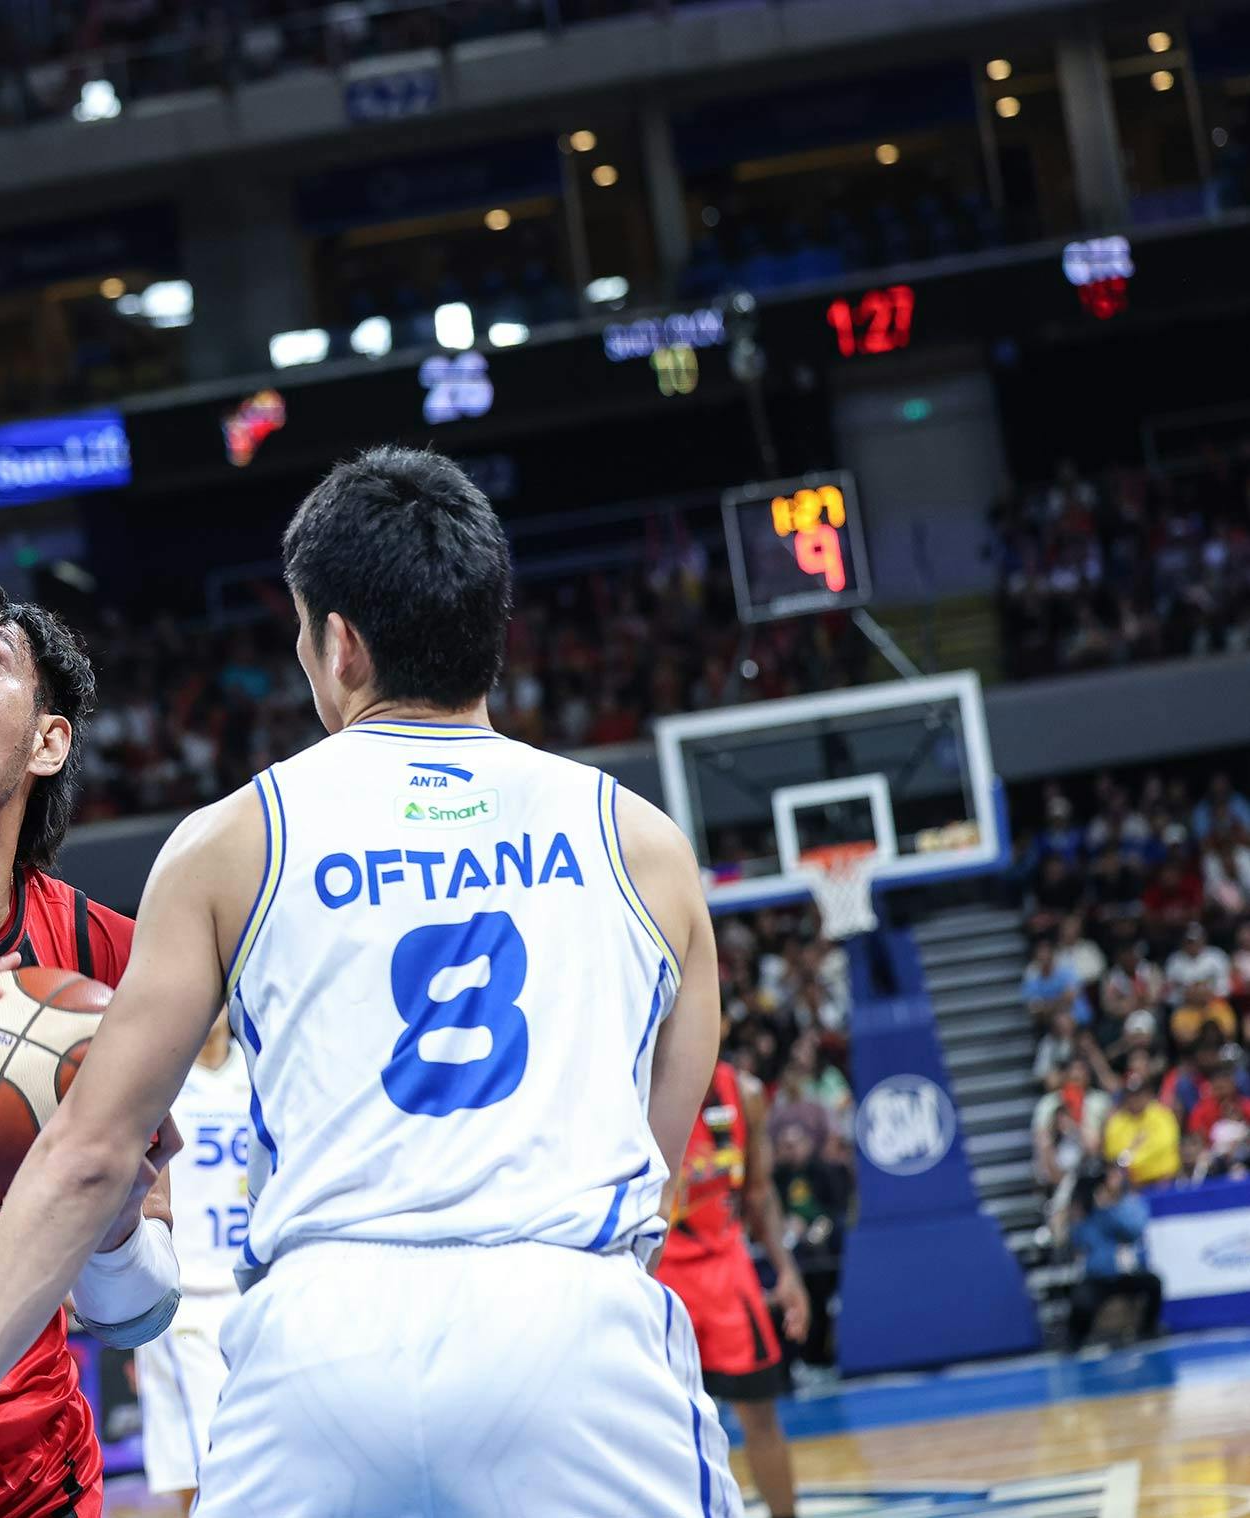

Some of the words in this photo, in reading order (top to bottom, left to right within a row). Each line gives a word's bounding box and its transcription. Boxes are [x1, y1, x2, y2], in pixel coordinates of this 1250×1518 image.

[409, 775, 449, 788] ANTA
[428, 799, 489, 822] Smart
[314, 832, 585, 910] OFTANA
[380, 910, 529, 1118] 8
